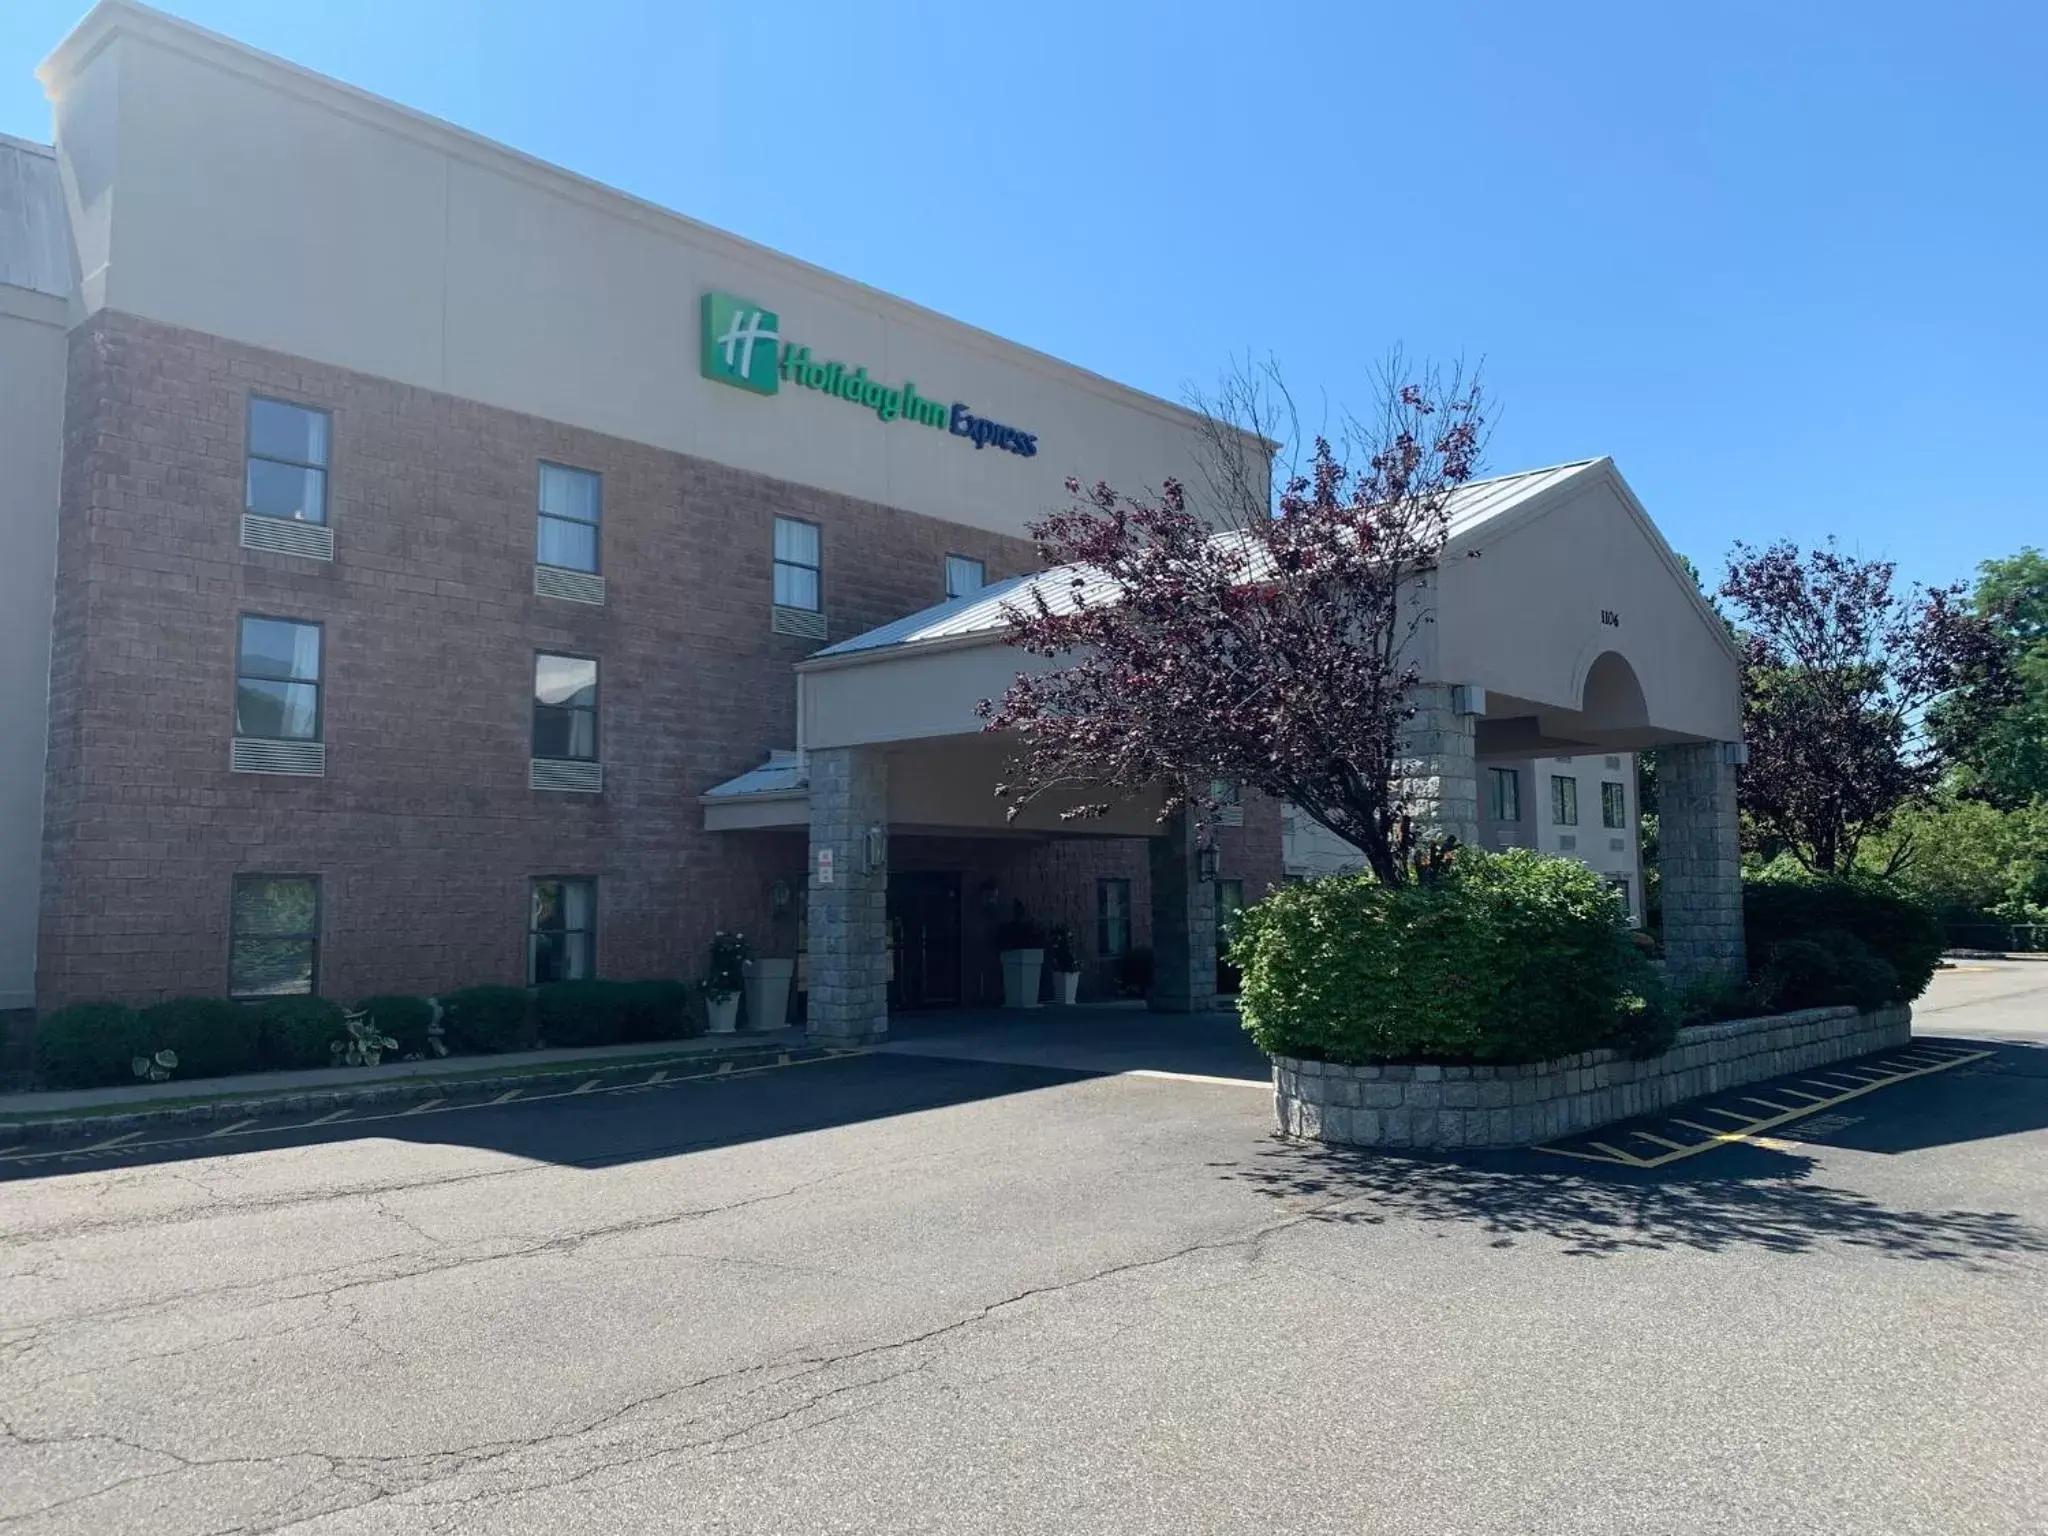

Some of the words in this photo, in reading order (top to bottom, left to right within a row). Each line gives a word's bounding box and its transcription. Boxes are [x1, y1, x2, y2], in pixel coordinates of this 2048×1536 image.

[779, 341, 901, 423] Holiday
[901, 381, 949, 430] Inn
[949, 402, 1038, 457] Express
